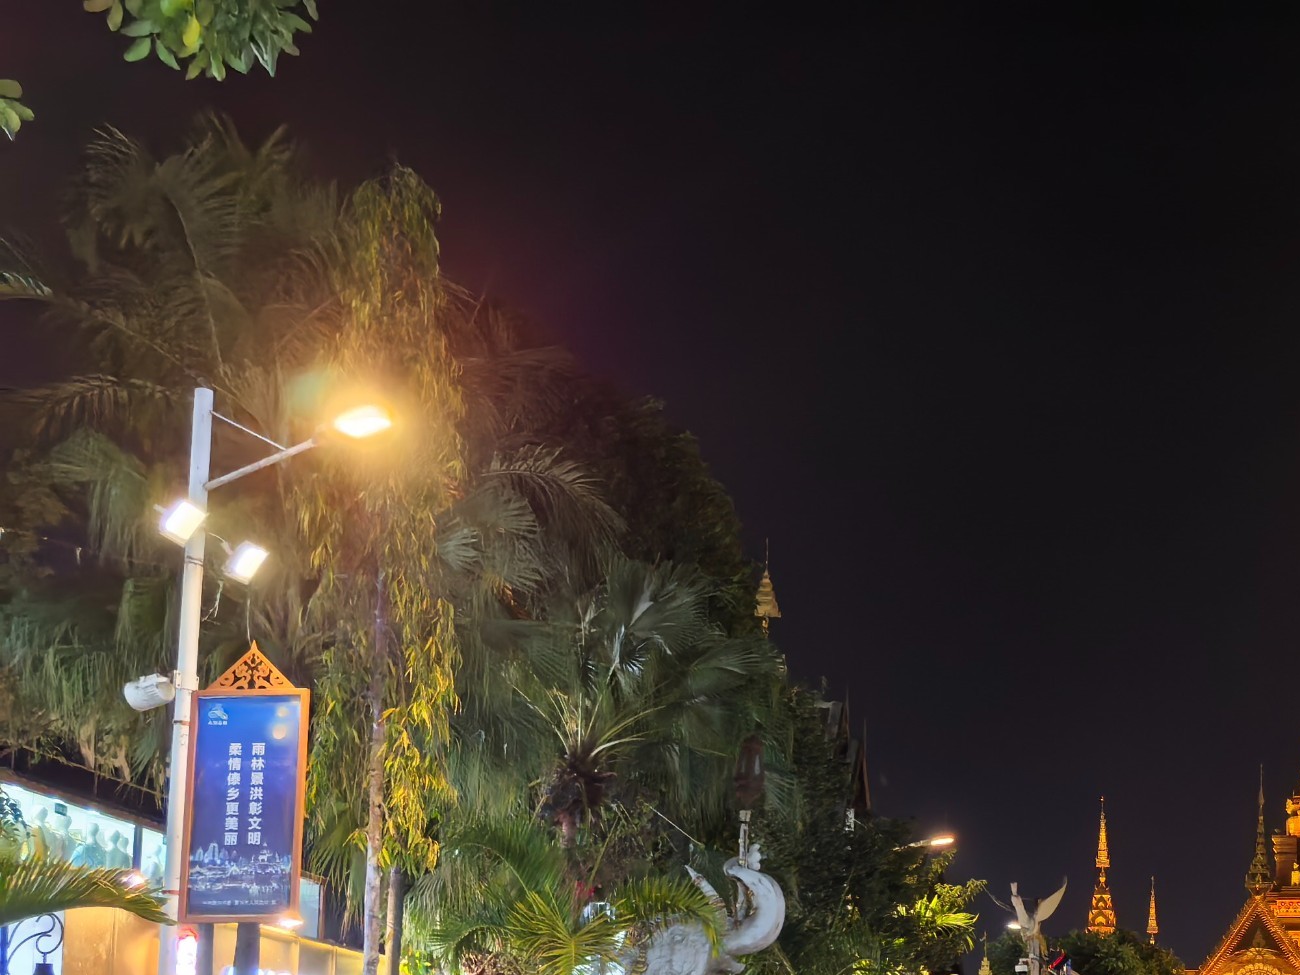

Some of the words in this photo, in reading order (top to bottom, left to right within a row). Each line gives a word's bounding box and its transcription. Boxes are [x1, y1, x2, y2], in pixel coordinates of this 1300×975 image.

[224, 742, 242, 846] 柔情傣乡更美丽
[247, 742, 266, 845] 雨林景洪彰文明
